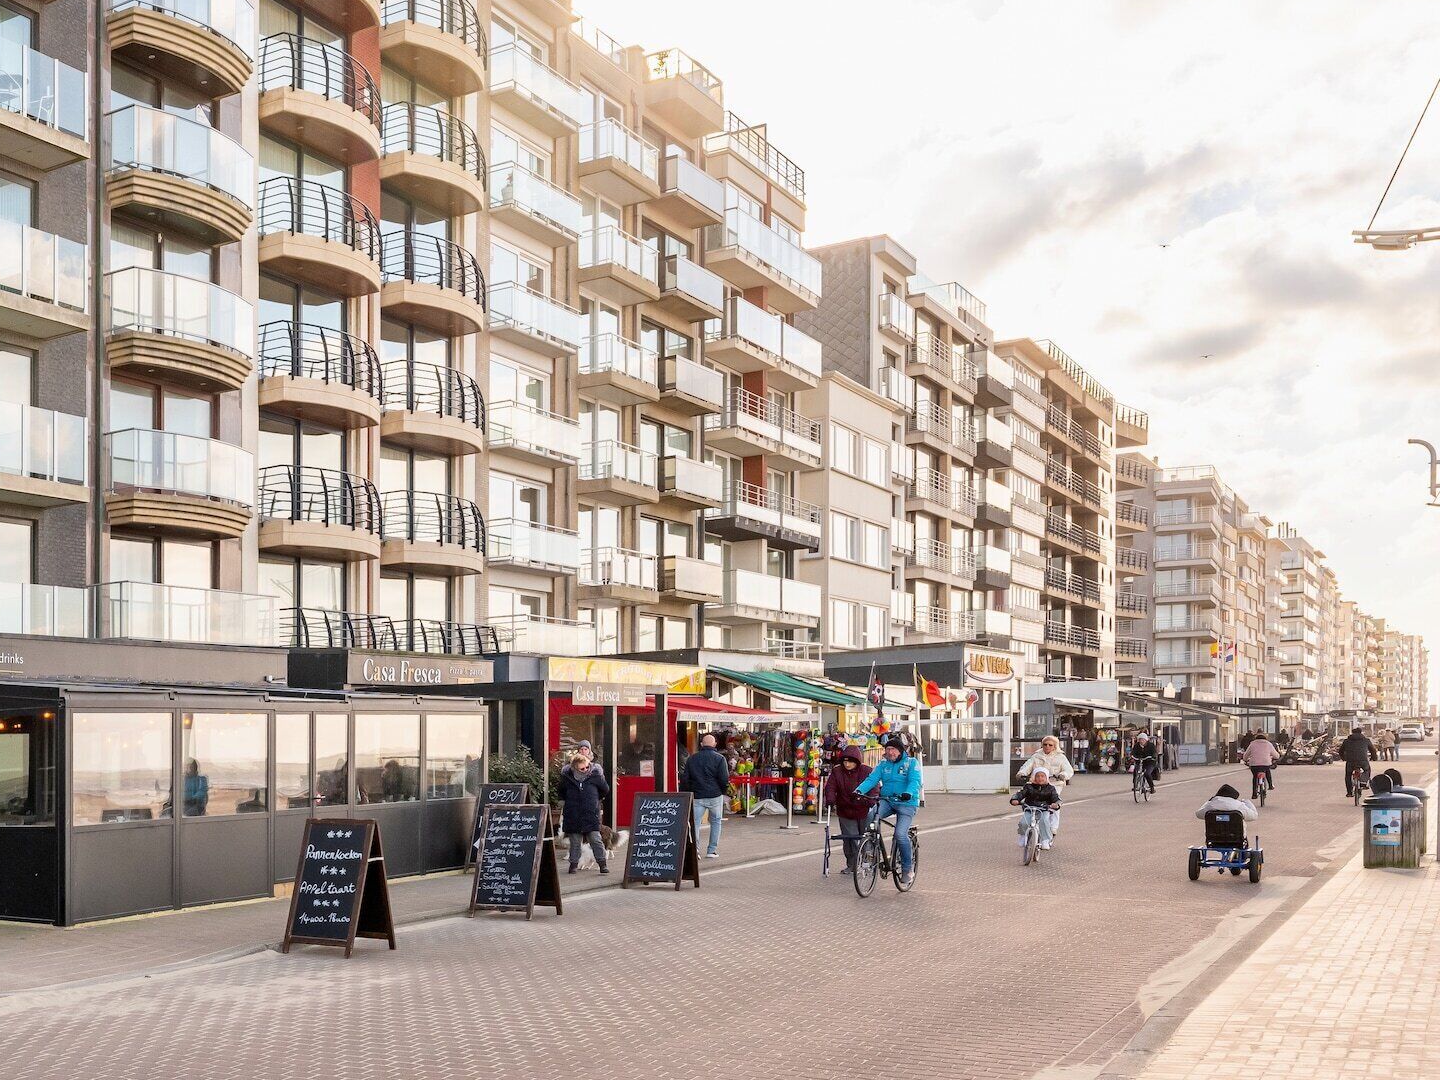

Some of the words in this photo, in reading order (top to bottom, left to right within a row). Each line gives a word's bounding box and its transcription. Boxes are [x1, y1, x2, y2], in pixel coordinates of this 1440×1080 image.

[363, 658, 396, 682] Casa
[400, 660, 442, 683] Fresca
[970, 653, 985, 672] LAS
[986, 655, 1011, 675] VEGAS
[576, 685, 595, 702] Casa
[596, 686, 620, 702] Fresca
[488, 789, 520, 802] OPEN
